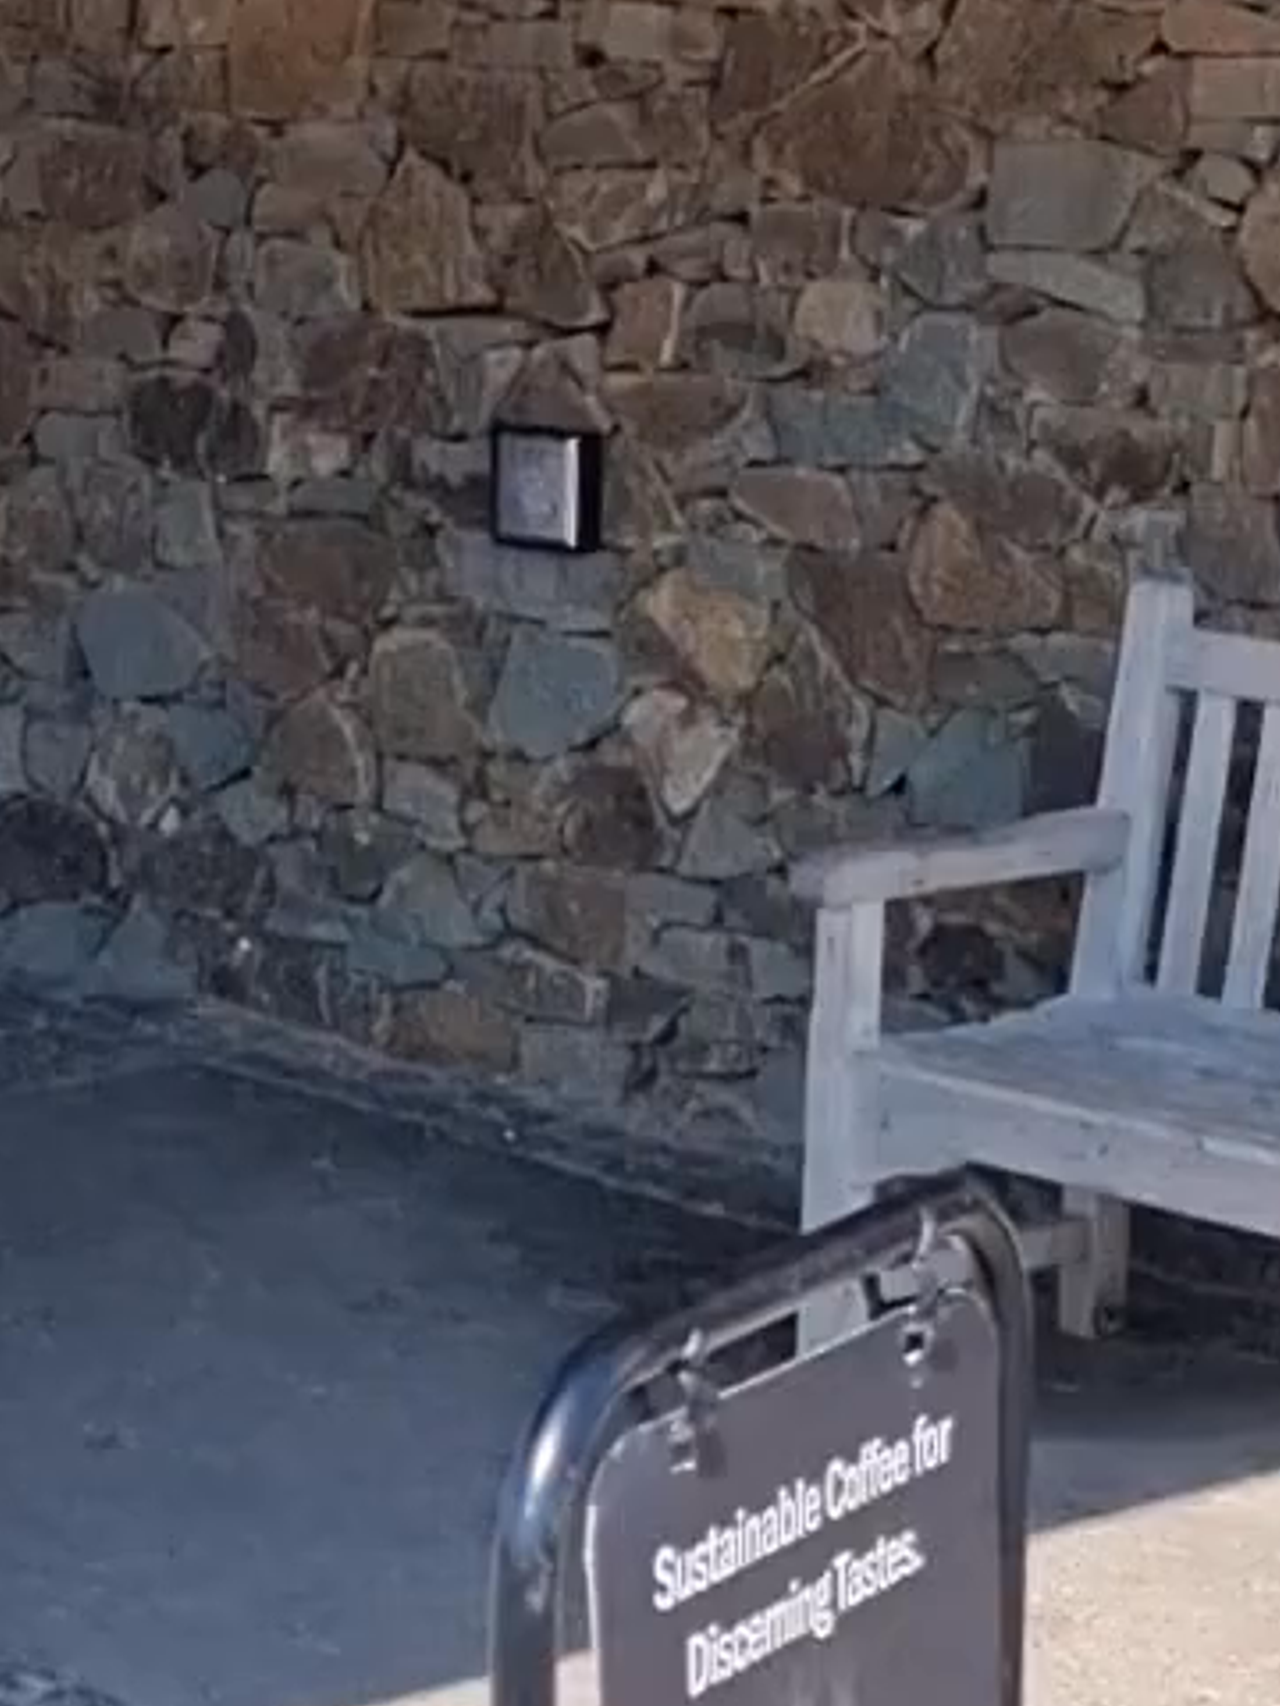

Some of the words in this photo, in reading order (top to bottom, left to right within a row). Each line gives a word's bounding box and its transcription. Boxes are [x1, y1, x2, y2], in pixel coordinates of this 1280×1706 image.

[653, 1476, 822, 1610] Sustainable
[824, 1435, 910, 1521] Coffee
[912, 1412, 955, 1476] for
[686, 1571, 834, 1698] Discerning
